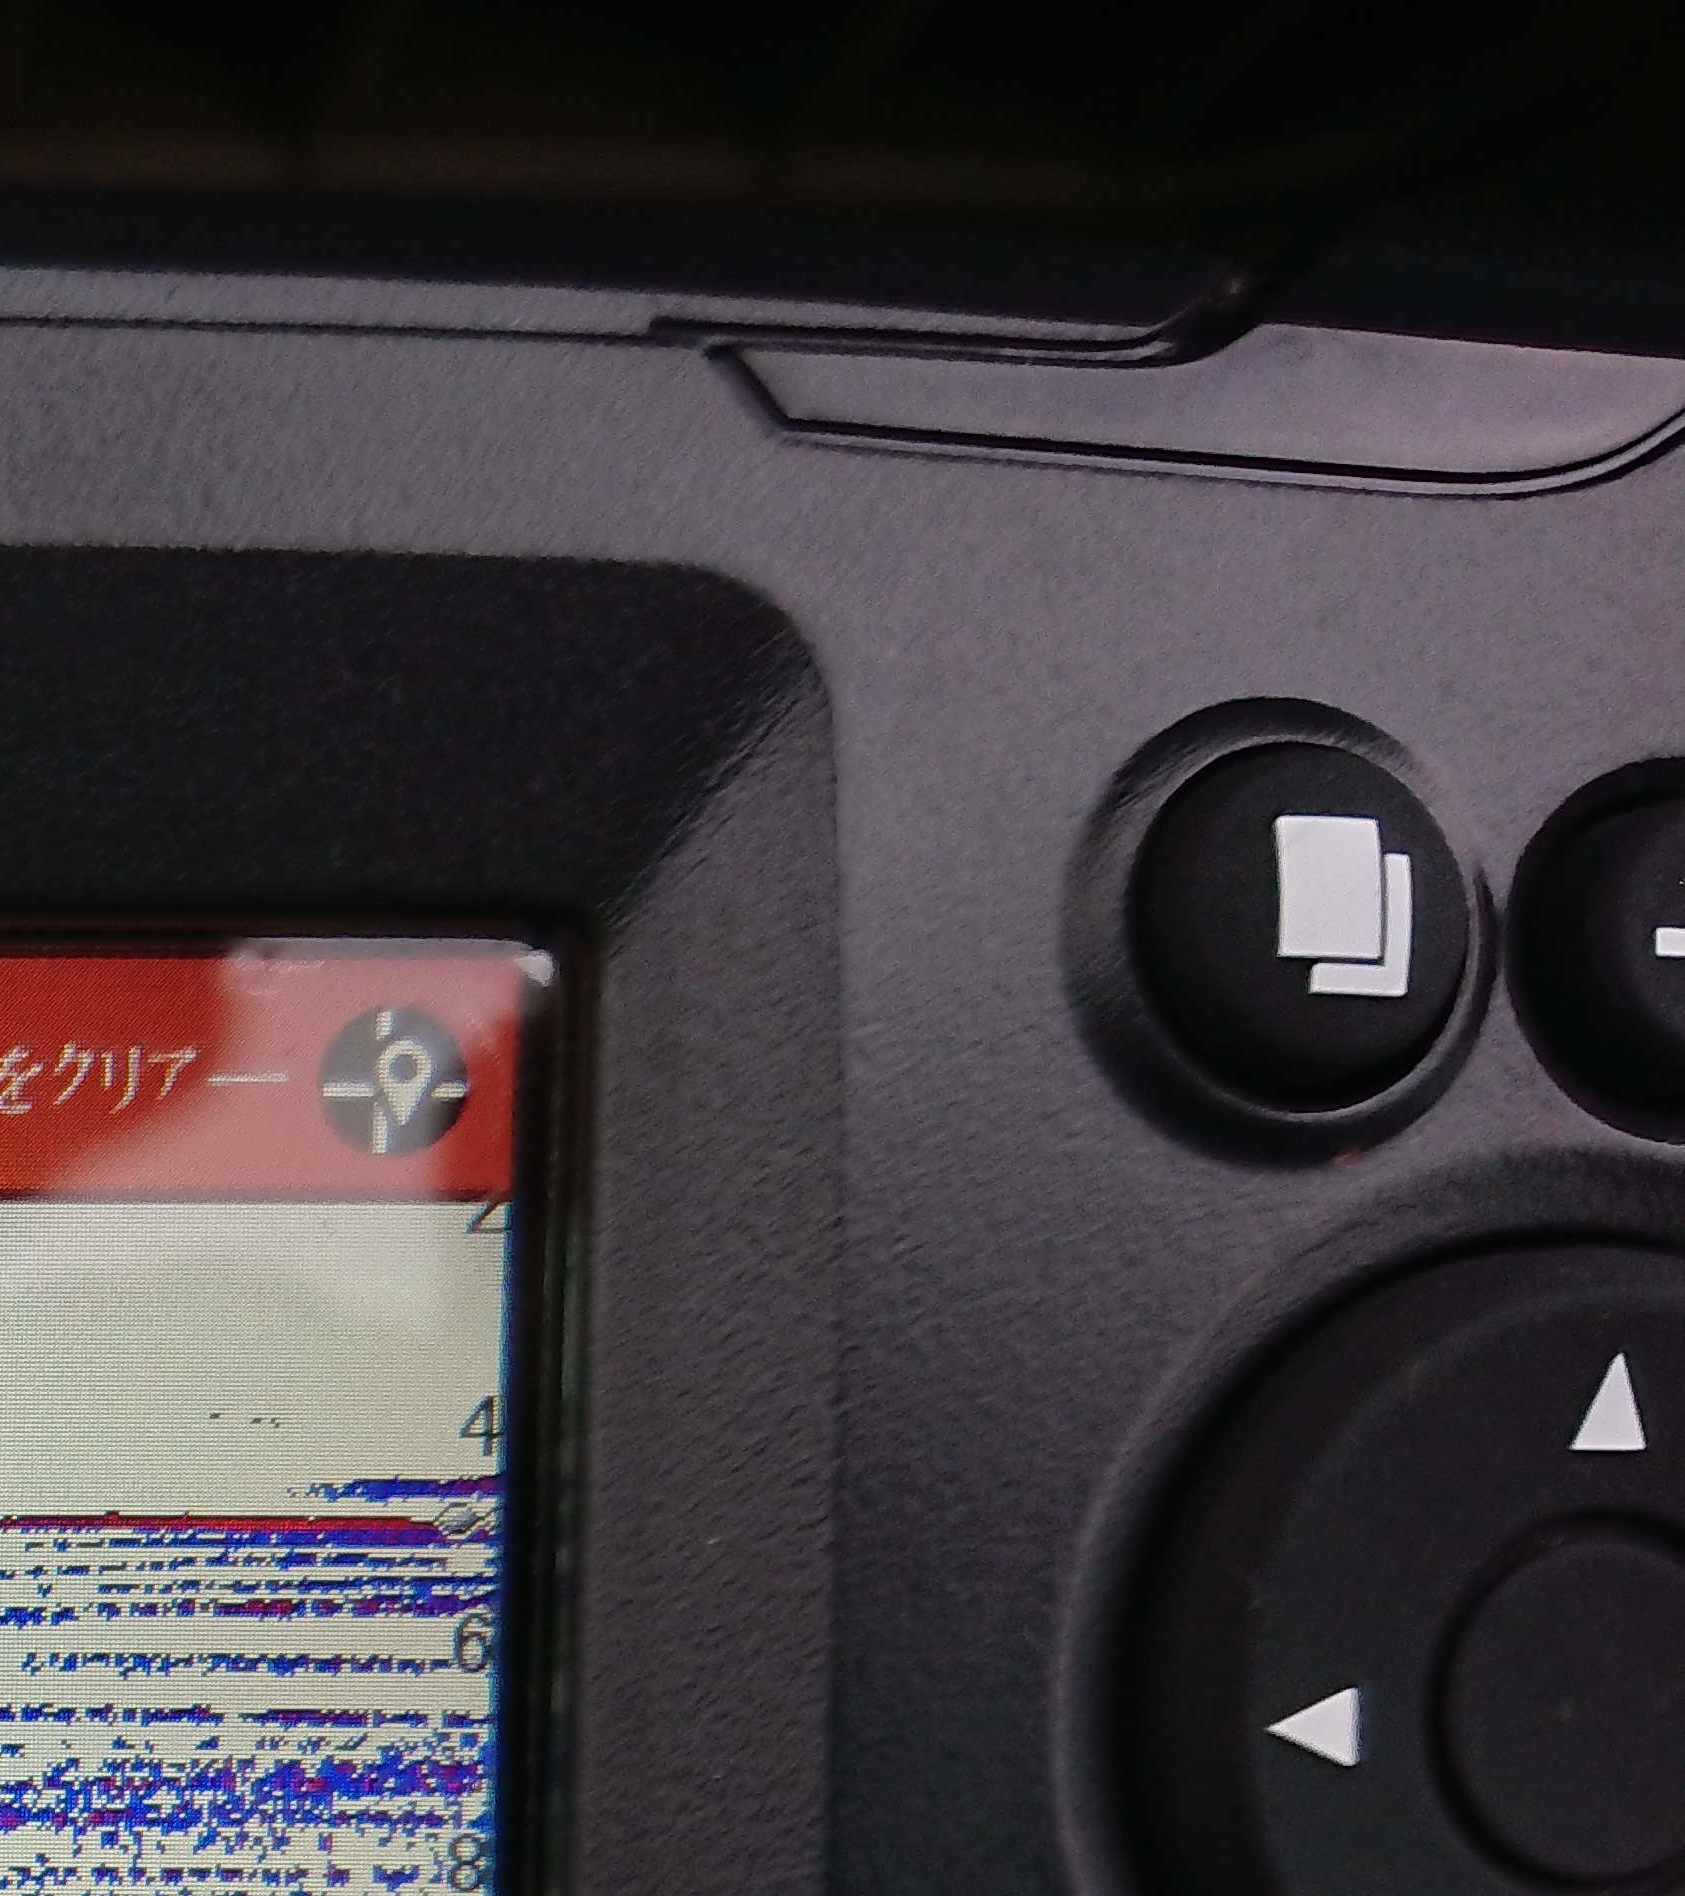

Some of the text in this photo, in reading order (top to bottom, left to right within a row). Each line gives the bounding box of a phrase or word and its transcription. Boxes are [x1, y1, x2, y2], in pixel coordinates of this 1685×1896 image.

[458, 1394, 505, 1457] 4
[452, 1610, 501, 1673] 6
[447, 1834, 490, 1892] 8
